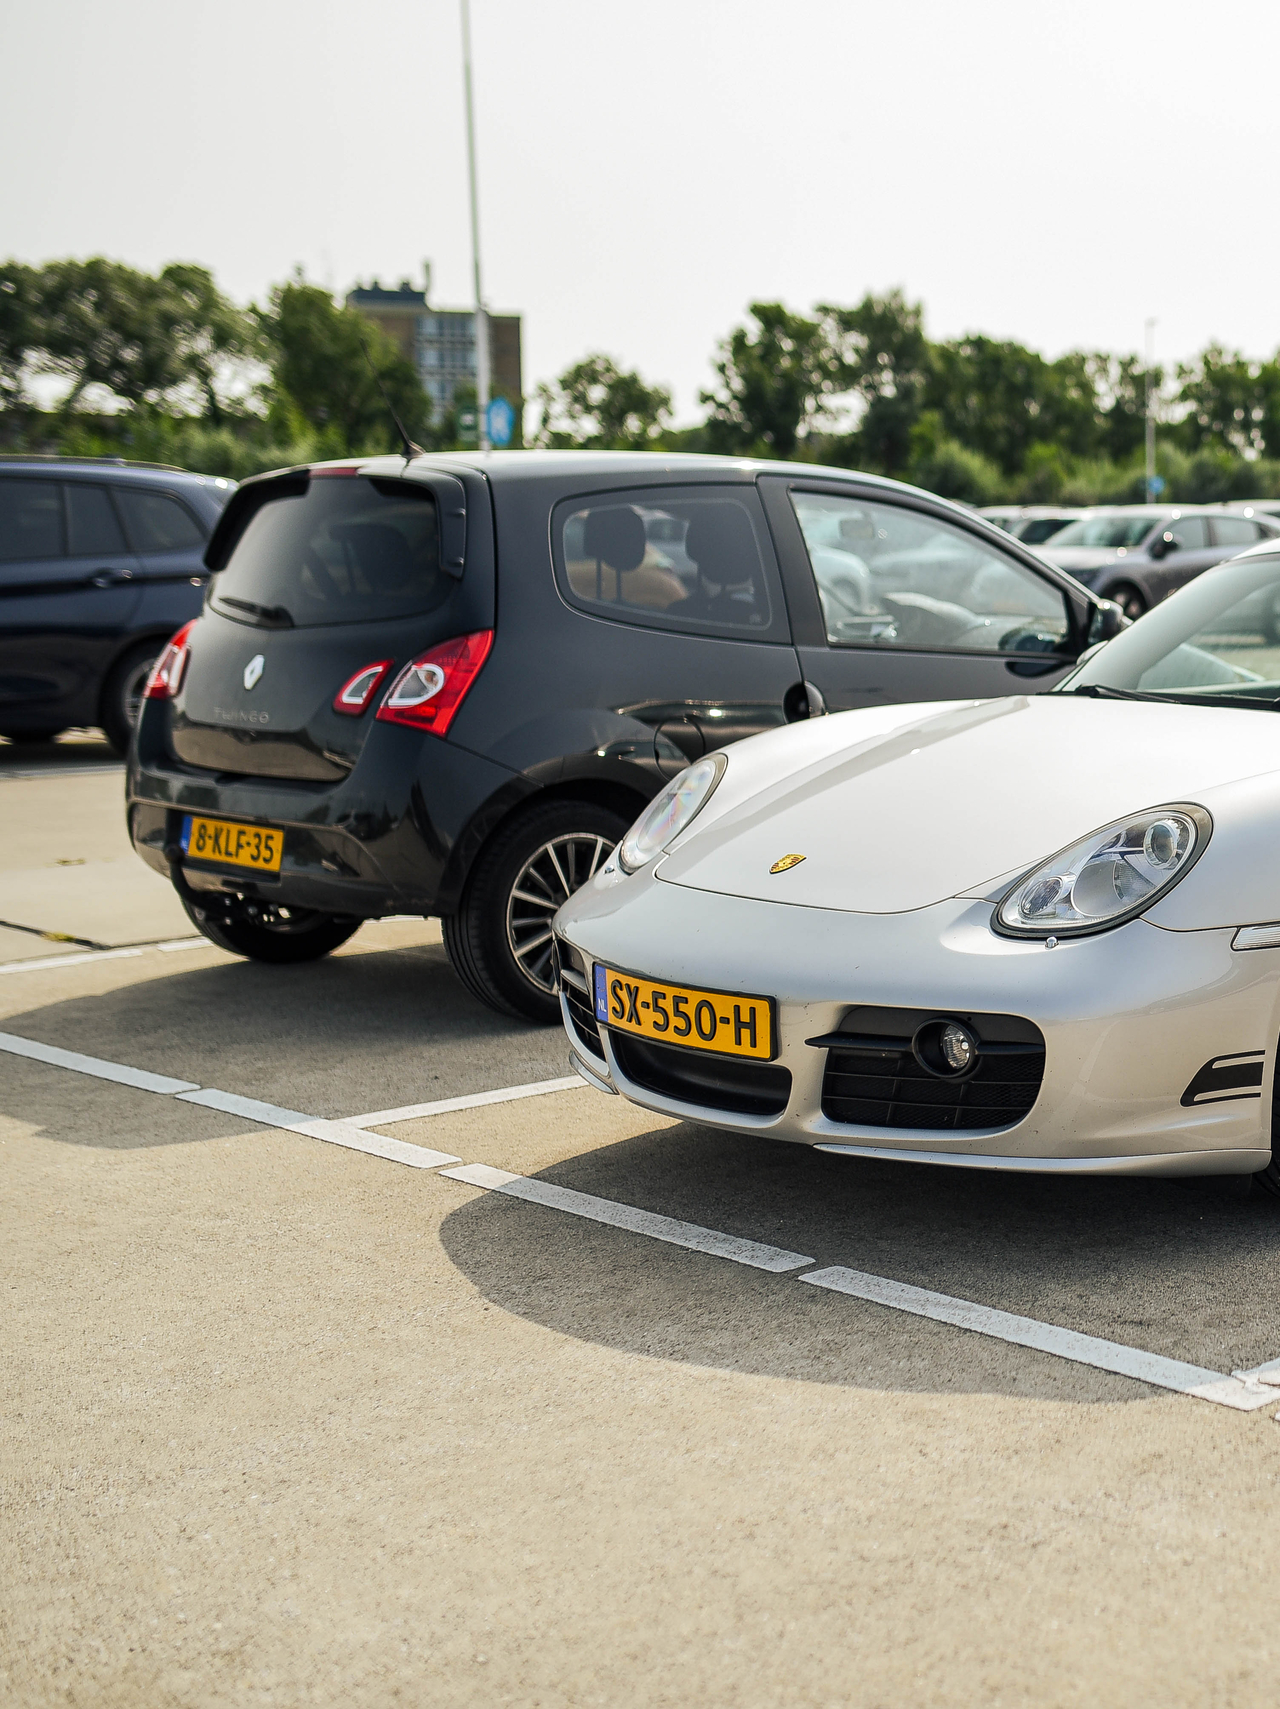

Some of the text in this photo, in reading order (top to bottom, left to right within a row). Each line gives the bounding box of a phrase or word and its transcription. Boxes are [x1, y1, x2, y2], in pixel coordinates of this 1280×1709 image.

[195, 822, 275, 865] 8-KLF-35
[597, 997, 607, 1013] NL
[610, 979, 758, 1049] SX-550-H
